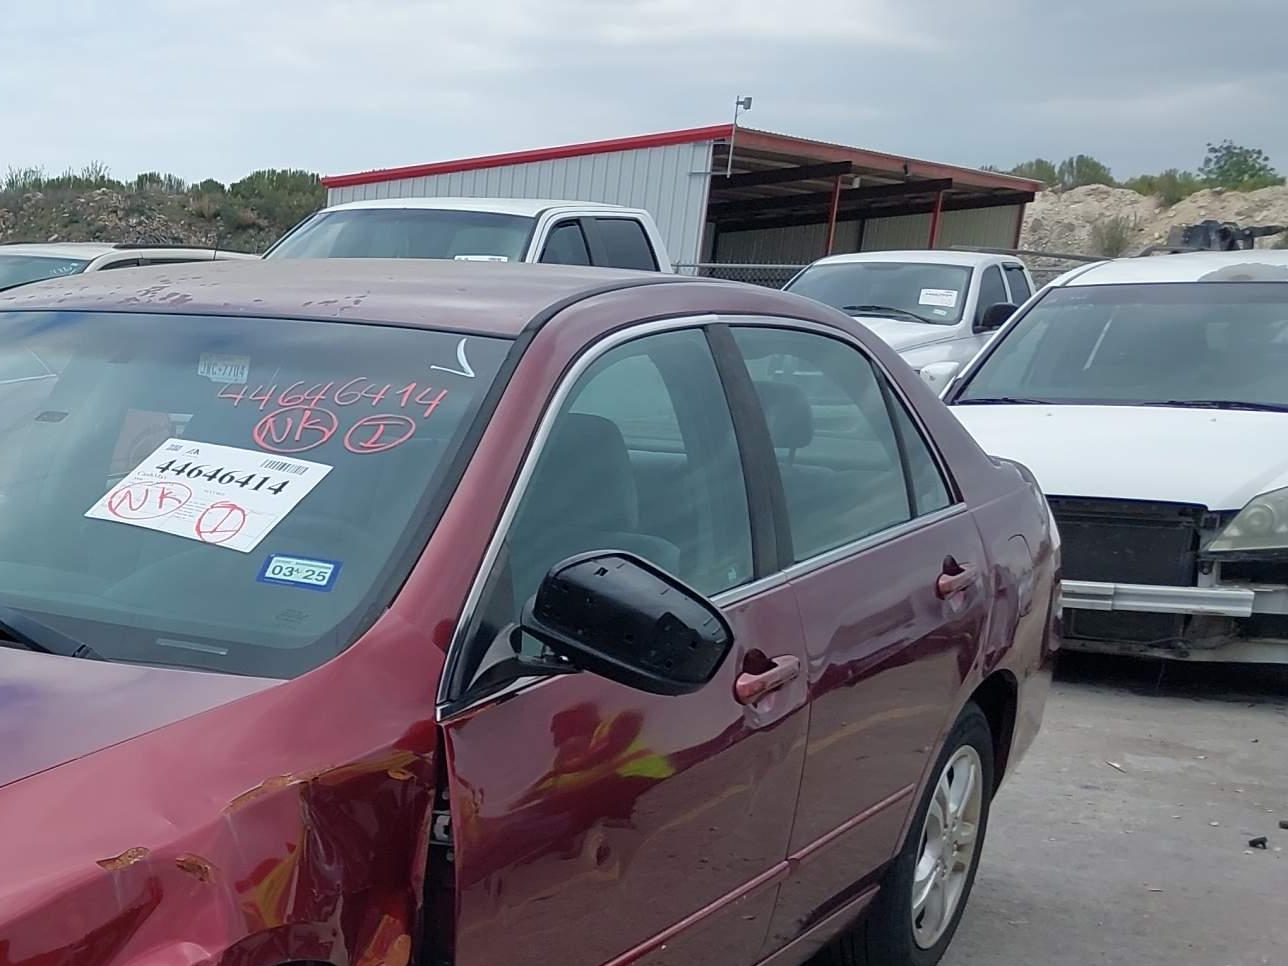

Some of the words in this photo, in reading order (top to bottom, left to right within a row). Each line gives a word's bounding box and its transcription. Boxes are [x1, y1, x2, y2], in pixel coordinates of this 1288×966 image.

[217, 377, 448, 418] 44646414
[260, 409, 332, 444] NK
[155, 459, 290, 496] 44646414
[112, 486, 183, 512] NK
[272, 565, 294, 577] 03
[303, 569, 328, 582] 25
